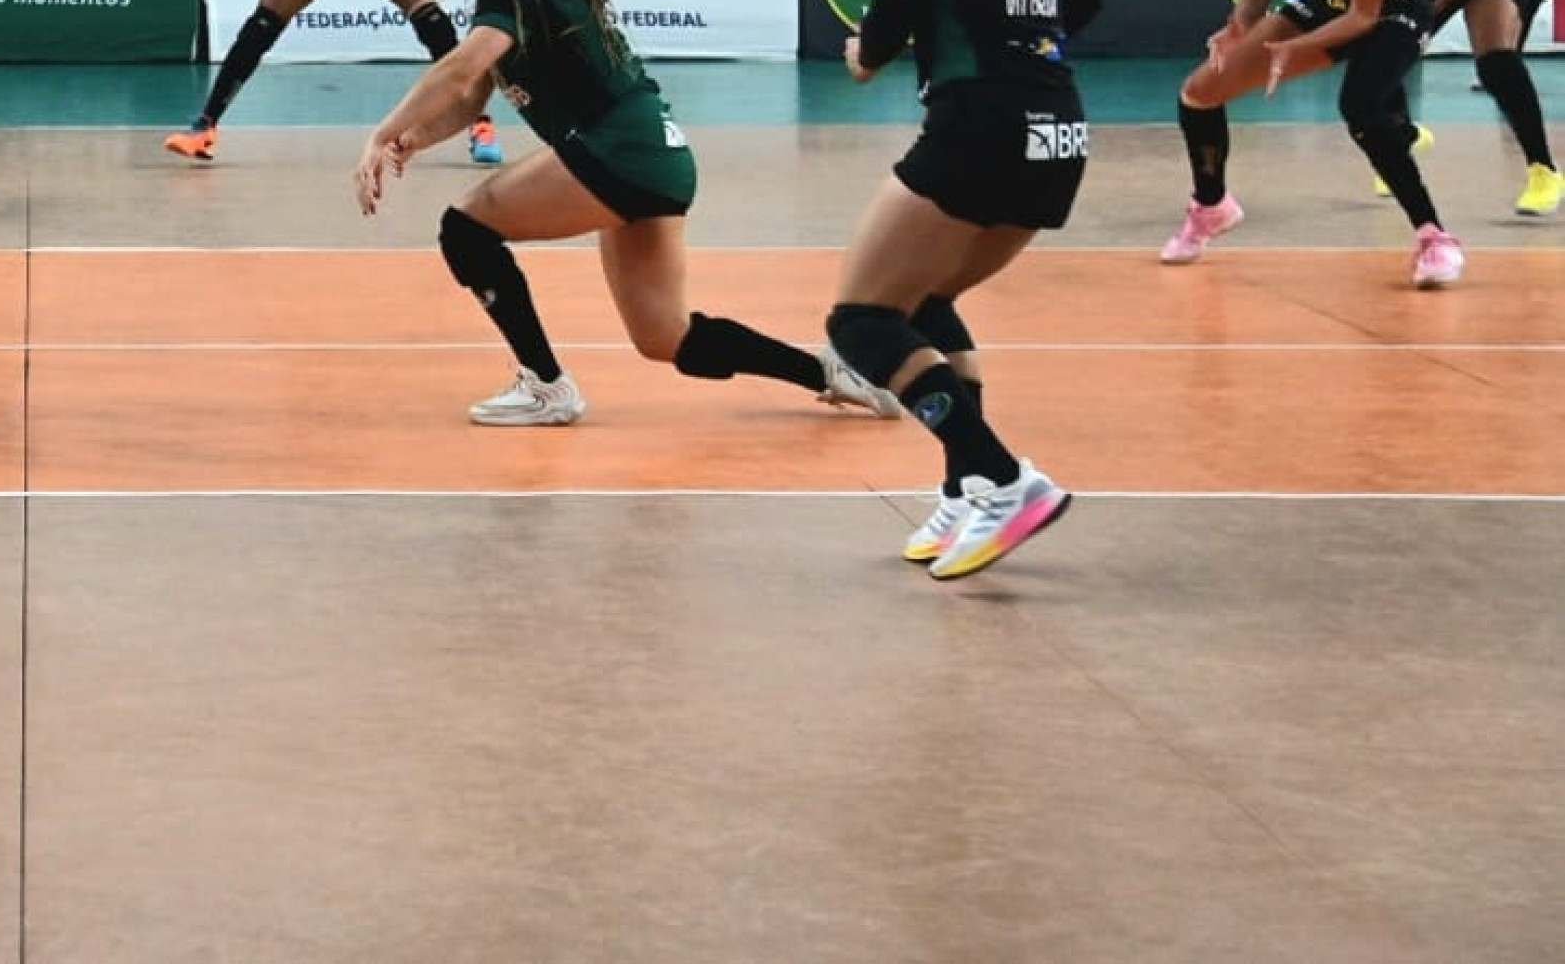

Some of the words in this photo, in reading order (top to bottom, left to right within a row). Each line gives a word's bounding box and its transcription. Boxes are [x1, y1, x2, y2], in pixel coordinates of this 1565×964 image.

[297, 6, 407, 31] FEDERAÇÃO
[621, 10, 707, 28] FEDERAL
[1057, 123, 1089, 159] BR
